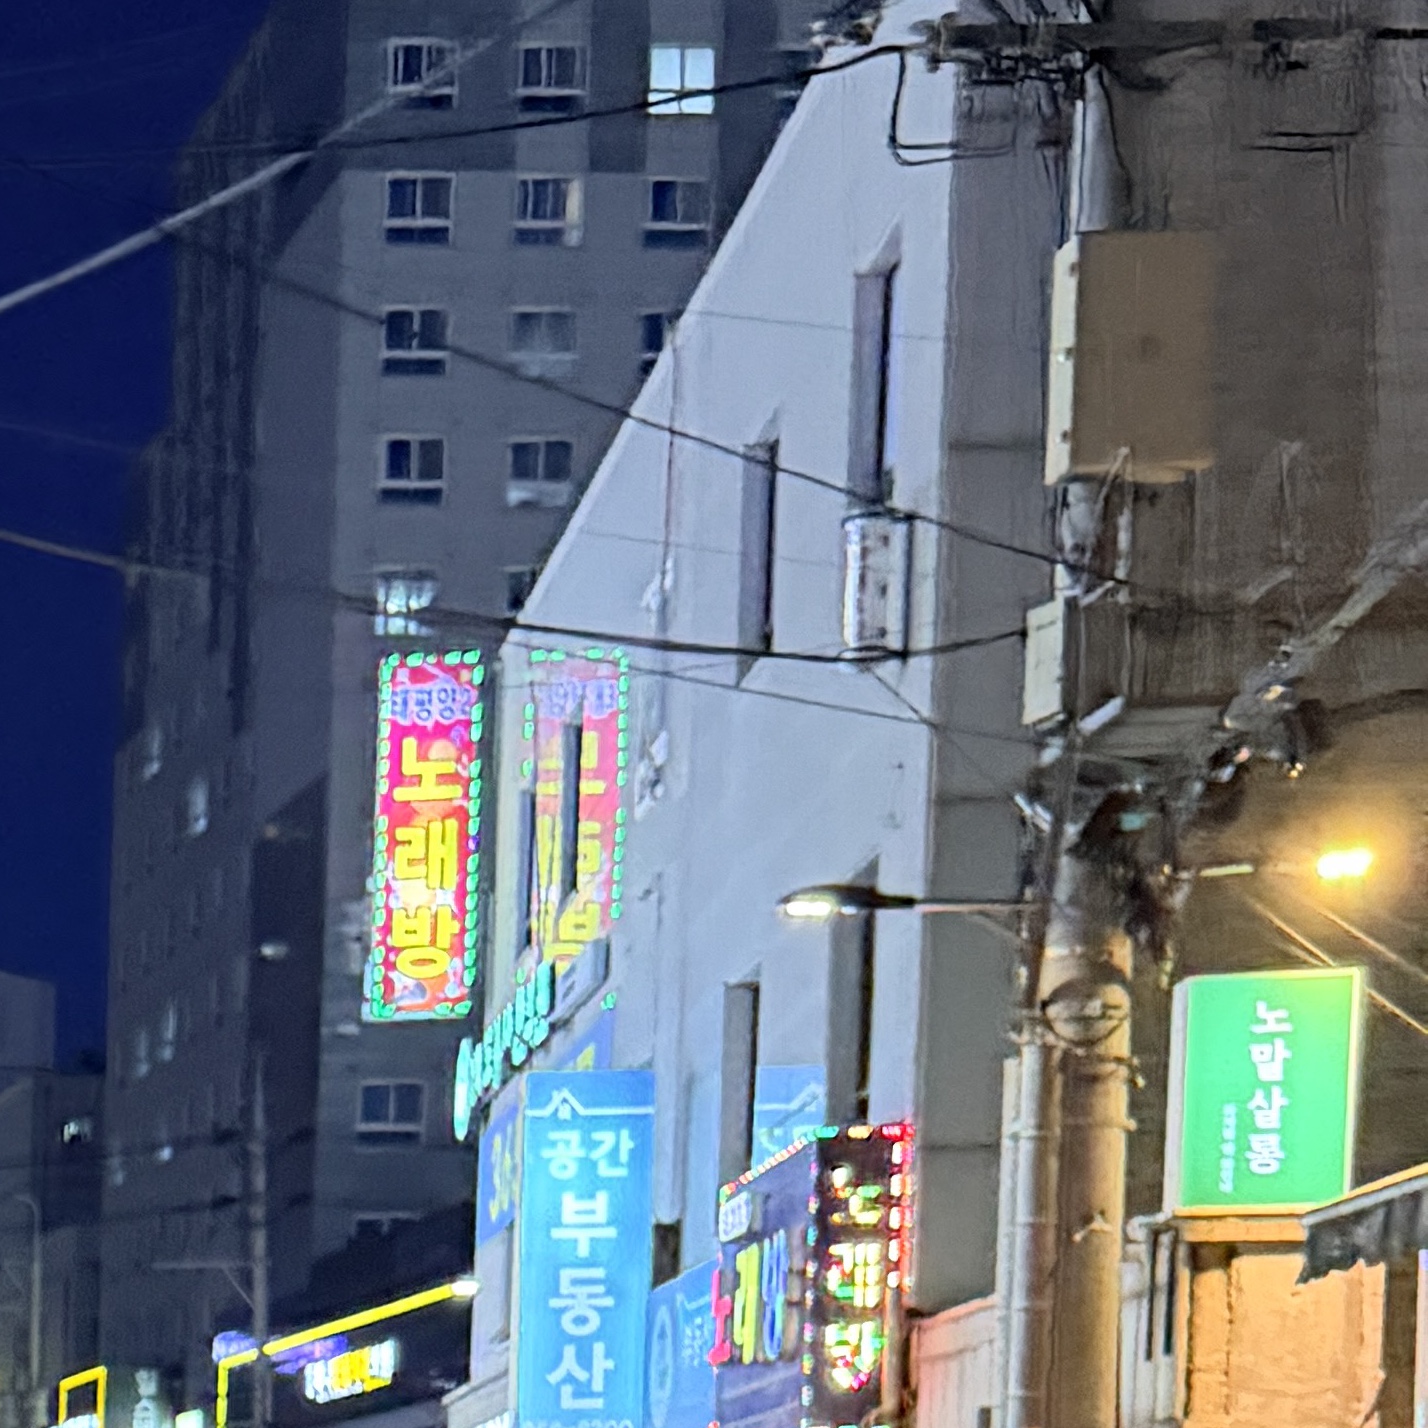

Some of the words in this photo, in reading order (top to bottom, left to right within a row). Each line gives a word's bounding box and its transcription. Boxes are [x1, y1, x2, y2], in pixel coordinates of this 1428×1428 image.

[390, 735, 464, 981] 노래방
[539, 1129, 635, 1181] 공간
[1245, 998, 1294, 1175] 노말살롱
[545, 1190, 618, 1411] 부동산
